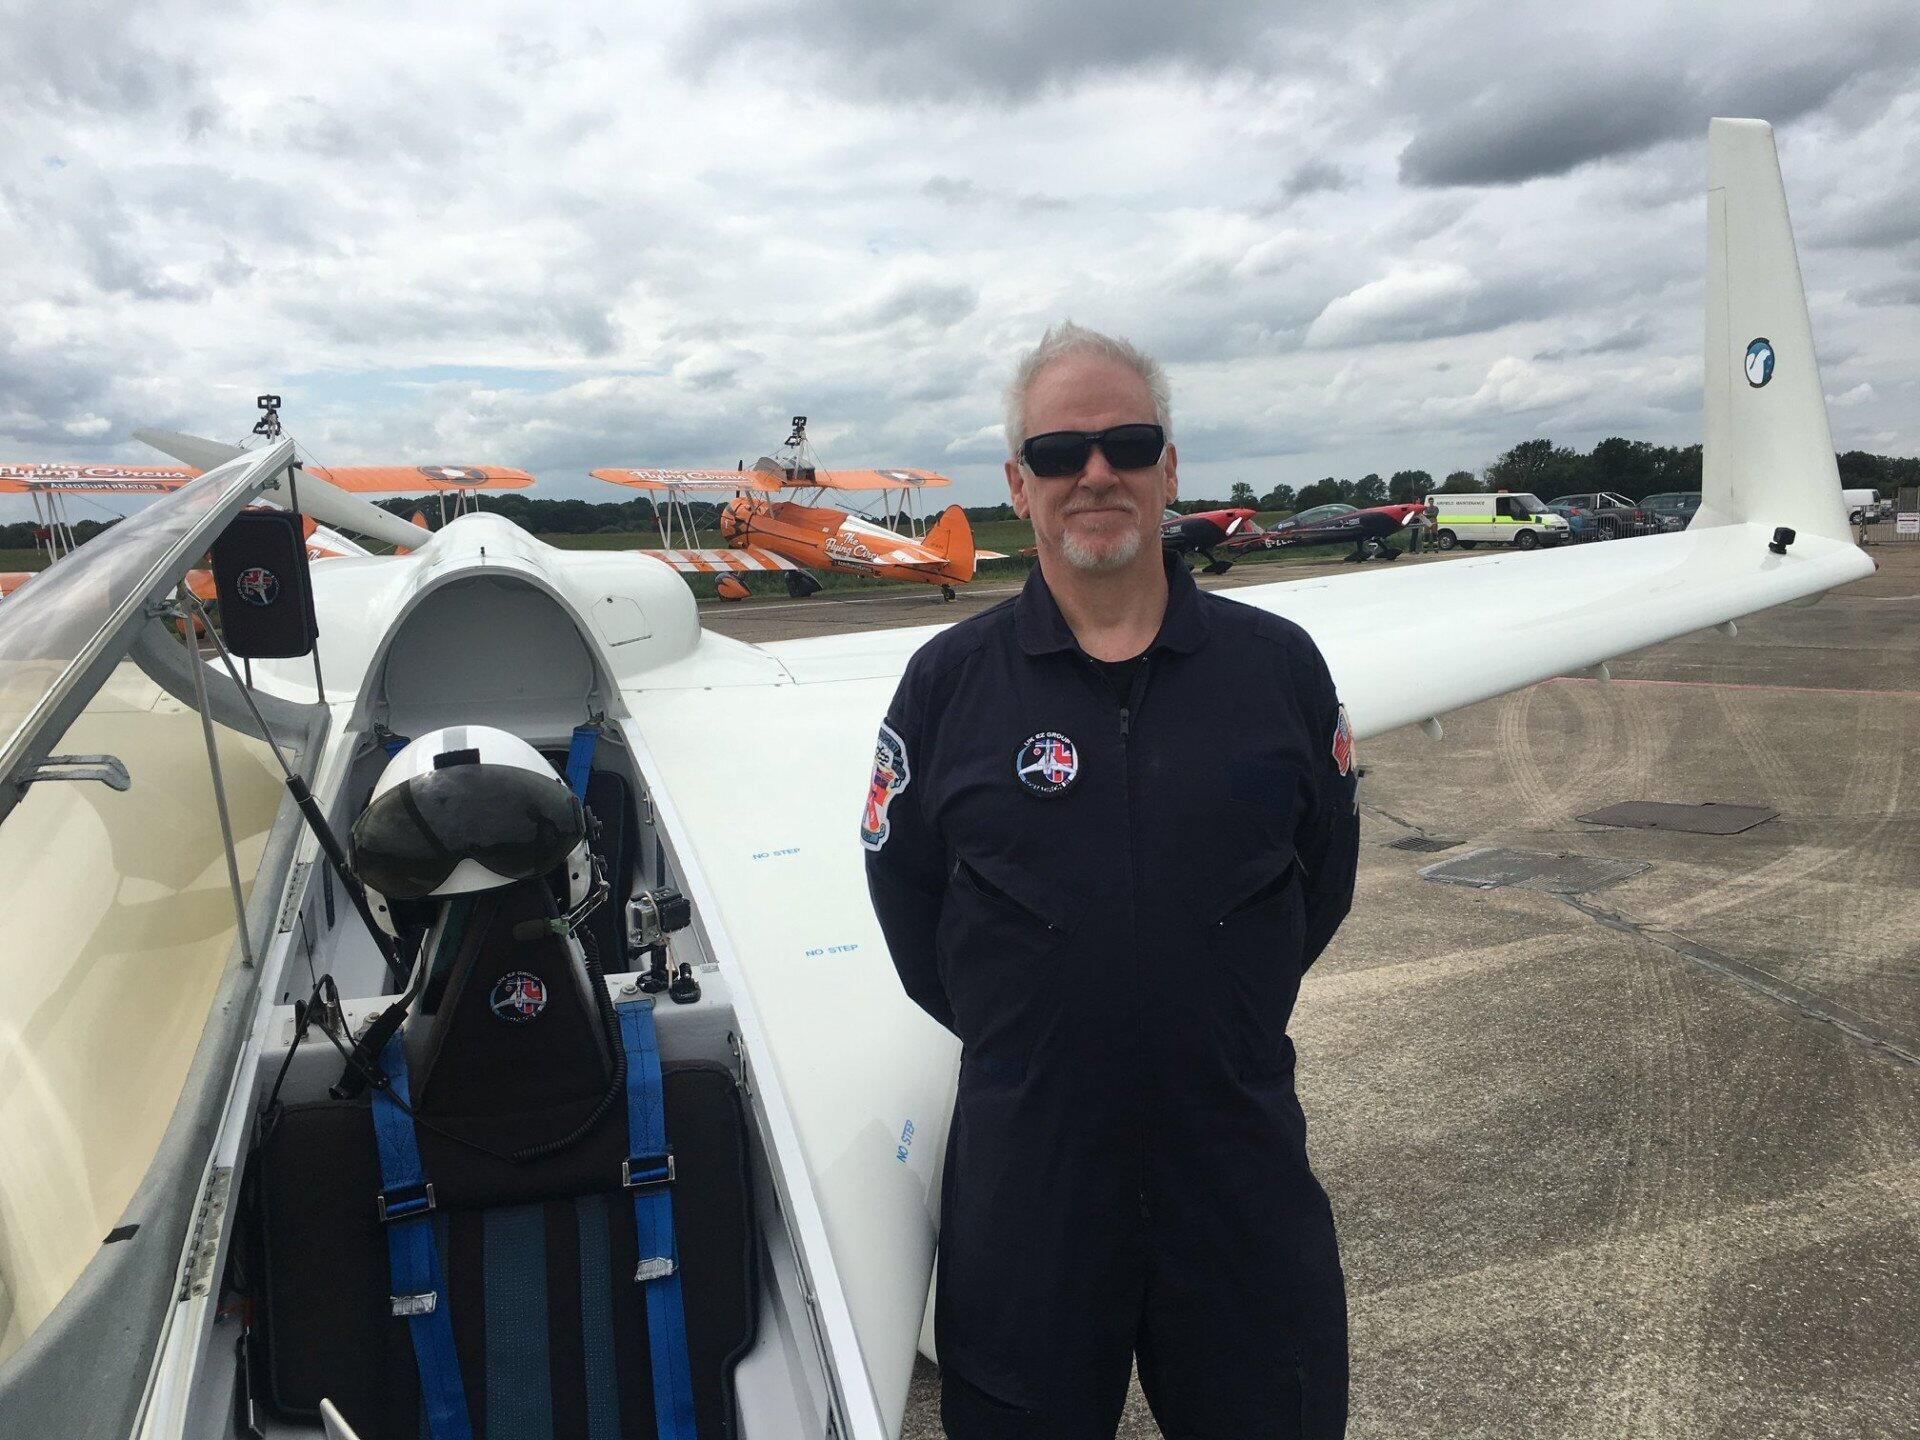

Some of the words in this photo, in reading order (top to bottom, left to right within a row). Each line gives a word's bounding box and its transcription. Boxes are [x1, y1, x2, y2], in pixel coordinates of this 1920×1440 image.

[825, 537, 852, 556] Flying
[843, 532, 860, 546] The
[1023, 736, 1035, 746] UK
[1046, 731, 1072, 744] GROUP
[773, 848, 801, 856] STEP
[828, 944, 858, 953] STEP
[901, 1119, 915, 1146] STEP
[896, 1145, 909, 1163] NO
